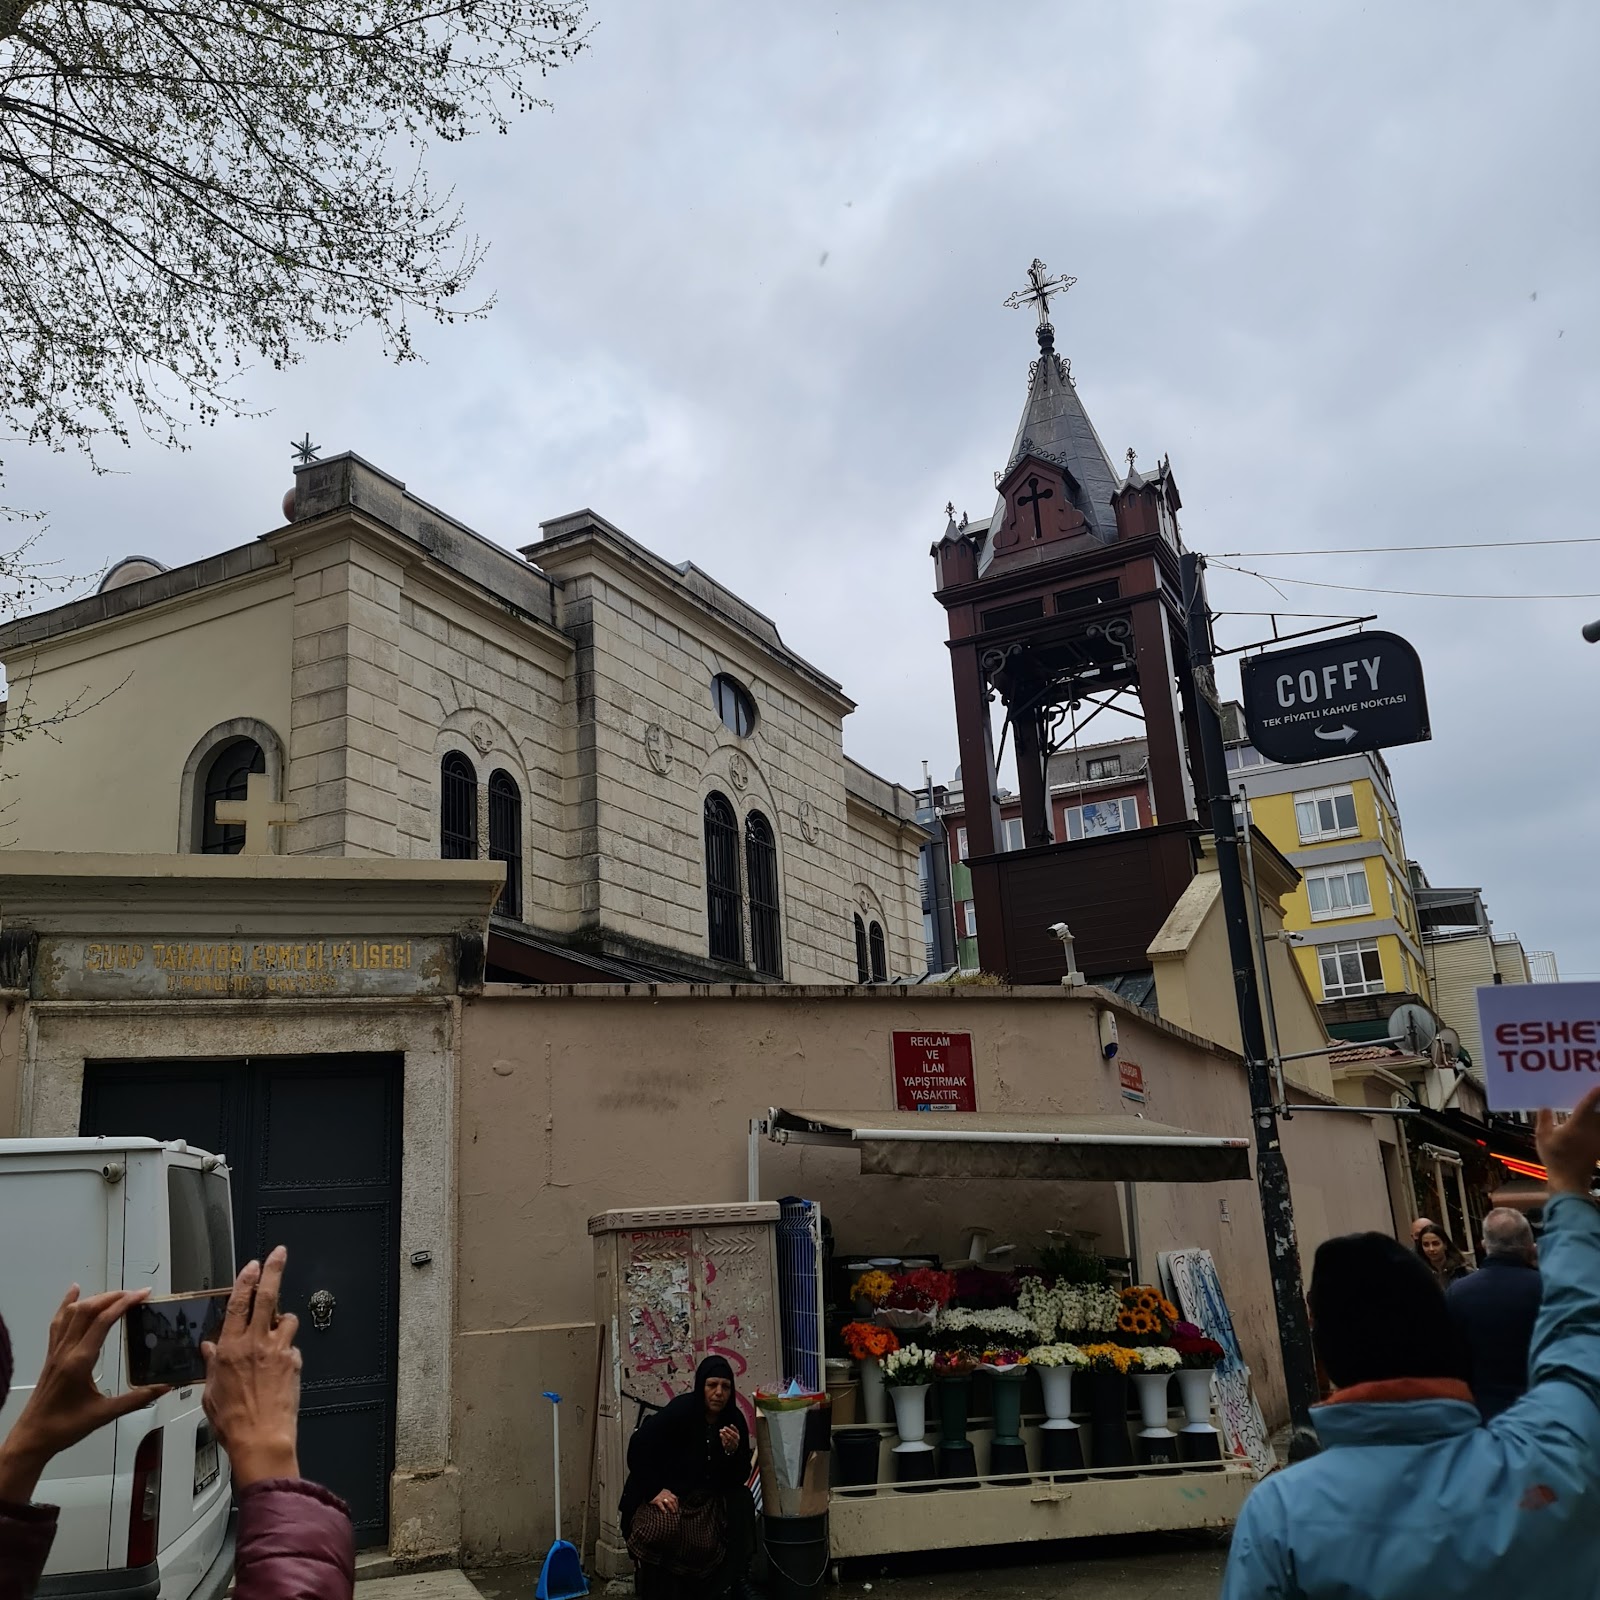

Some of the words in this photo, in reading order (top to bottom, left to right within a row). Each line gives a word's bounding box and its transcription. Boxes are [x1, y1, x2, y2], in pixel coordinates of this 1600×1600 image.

[1276, 656, 1381, 708] COFFY
[1262, 717, 1282, 728] TEK
[1284, 710, 1320, 724] FİYATLI
[1322, 703, 1358, 716] KAHVE
[1360, 694, 1407, 710] NOKTASI
[1494, 1020, 1600, 1045] ESHE
[910, 1036, 950, 1046] REKLAM
[926, 1050, 939, 1060] VE
[1497, 1048, 1600, 1072] TOUR
[922, 1061, 945, 1073] İLAN
[903, 1076, 967, 1089] YAPIŞTIRMAK
[910, 1090, 961, 1100] YASAKTIR.
